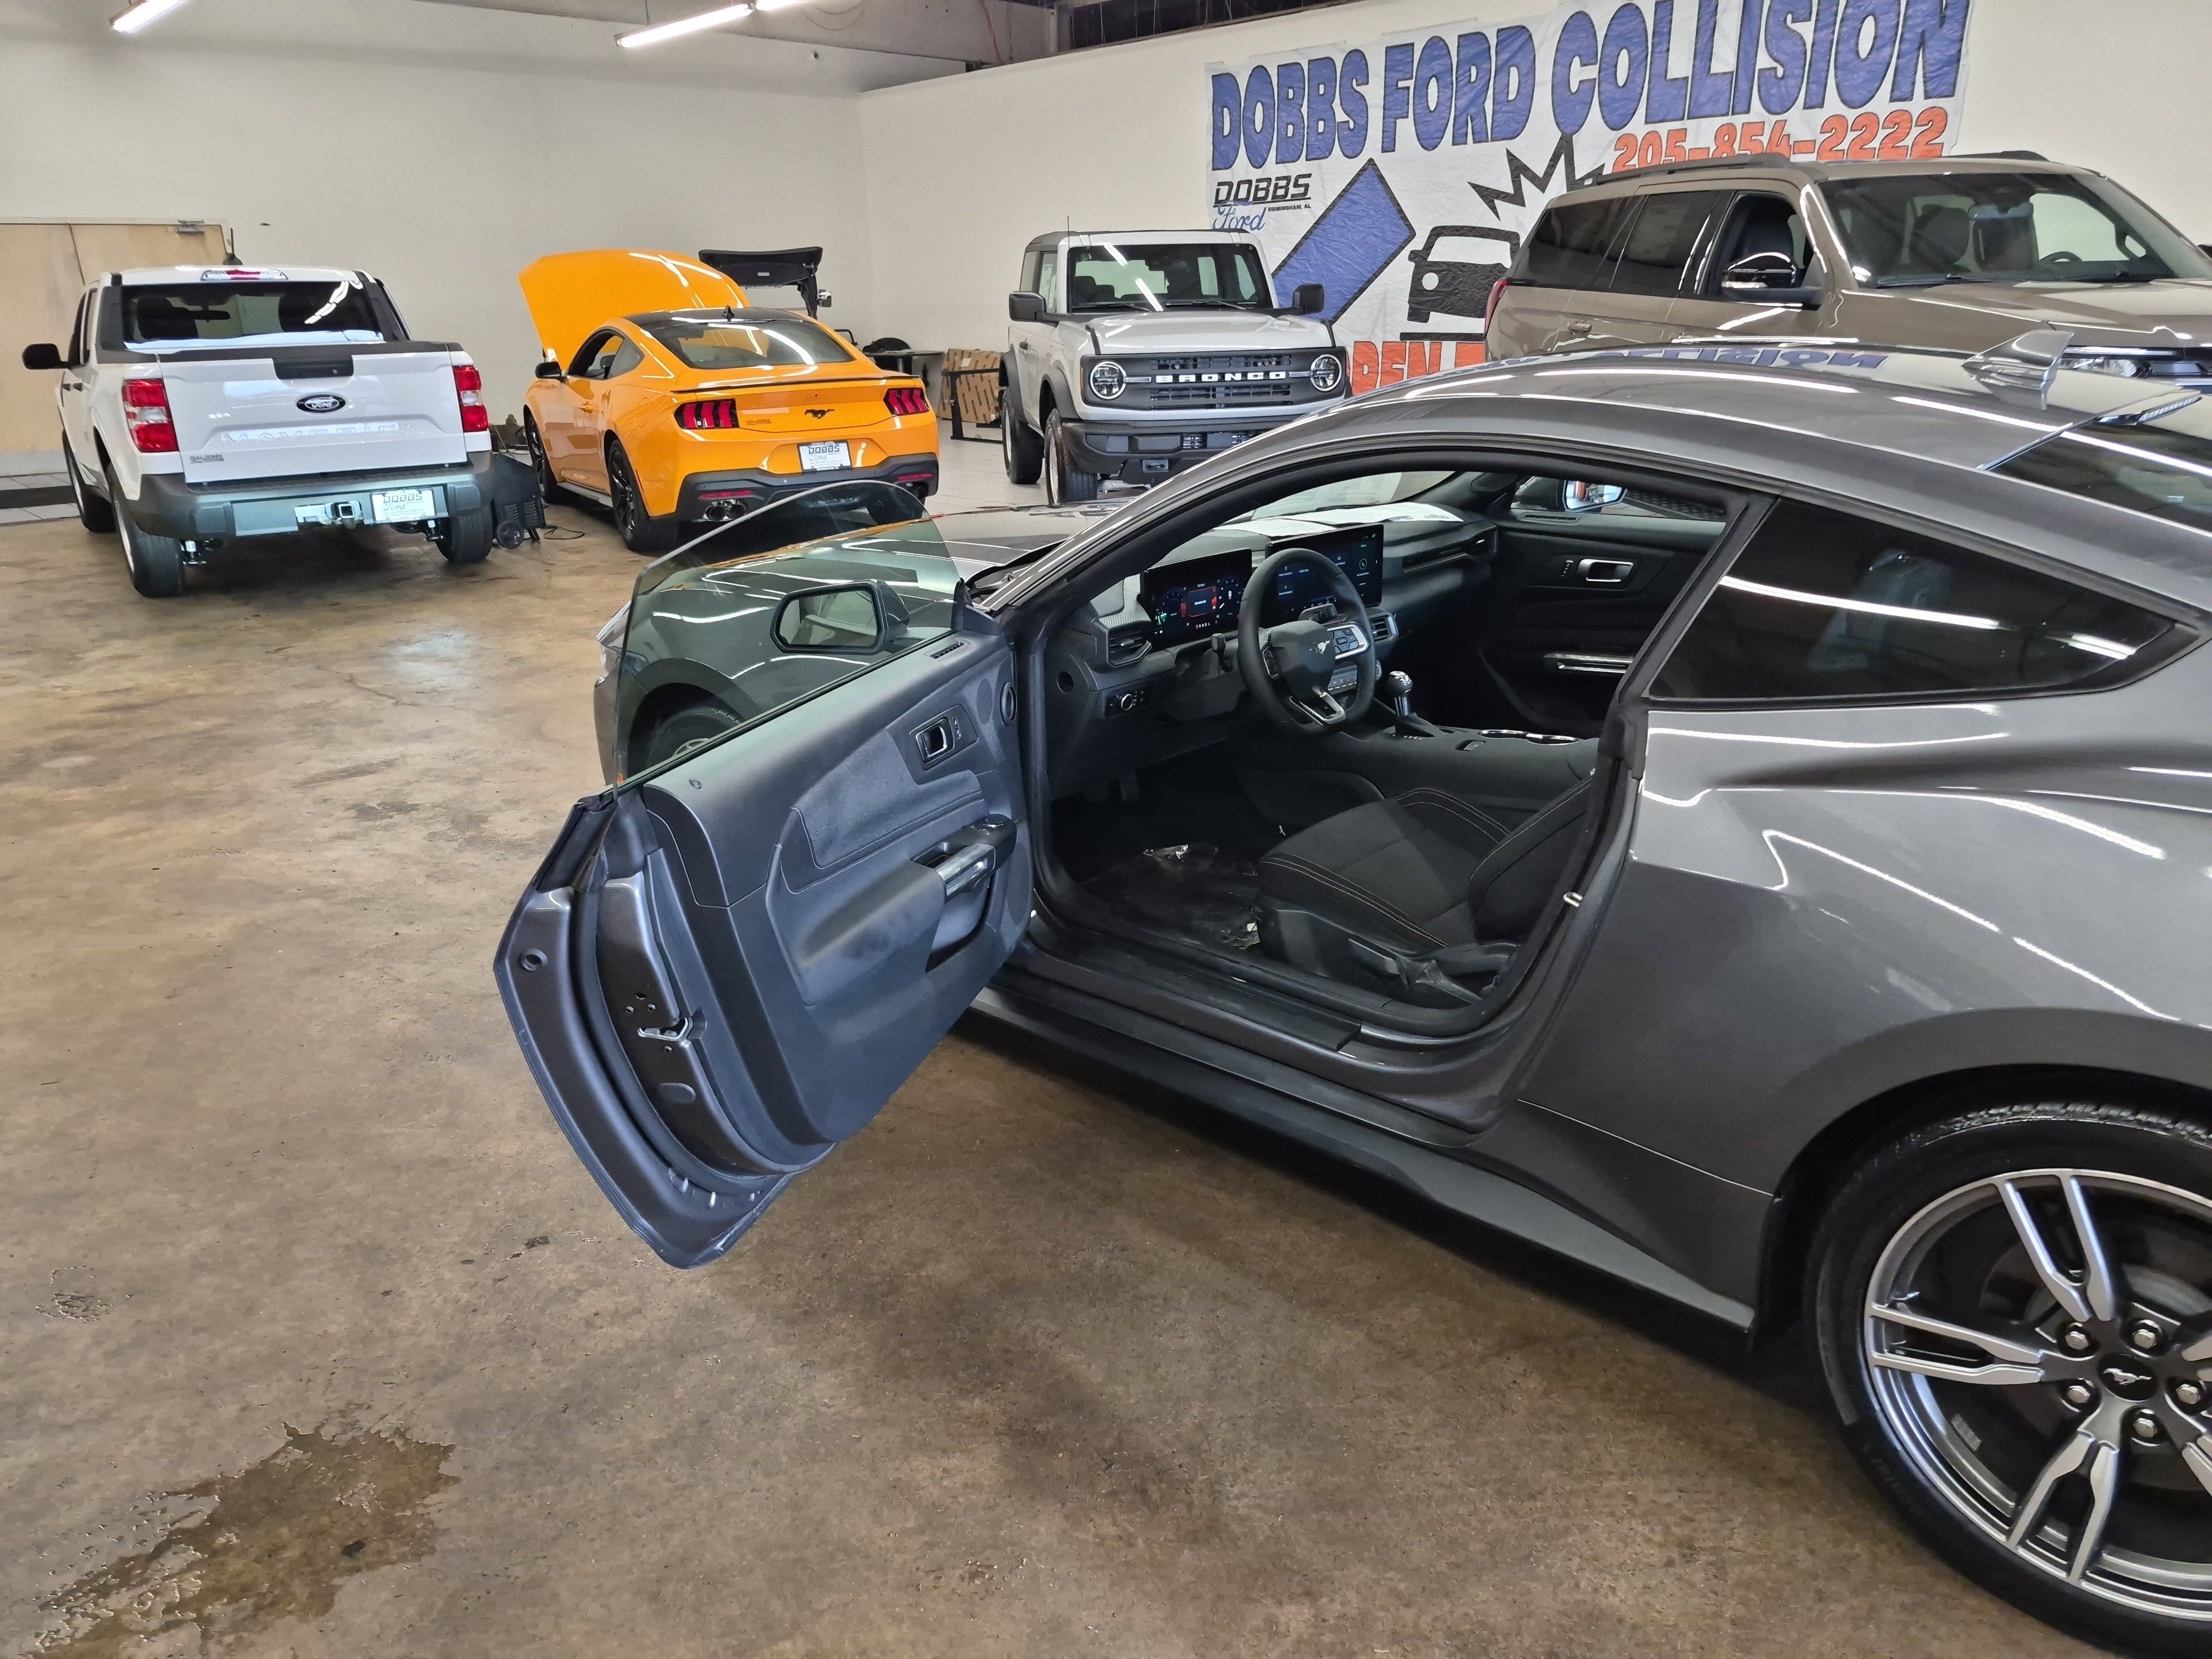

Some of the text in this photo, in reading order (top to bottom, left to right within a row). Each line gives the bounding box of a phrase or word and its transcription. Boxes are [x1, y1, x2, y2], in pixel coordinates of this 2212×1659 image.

[1211, 0, 1967, 171] DOBBS FORD COLLISION
[1612, 106, 1948, 173] 205-854-2222
[1214, 173, 1312, 204] DOBBS
[1212, 201, 1268, 232] Ford
[1155, 371, 1286, 383] BRONCO
[808, 445, 840, 454] DOBBS
[383, 503, 406, 511] Ford
